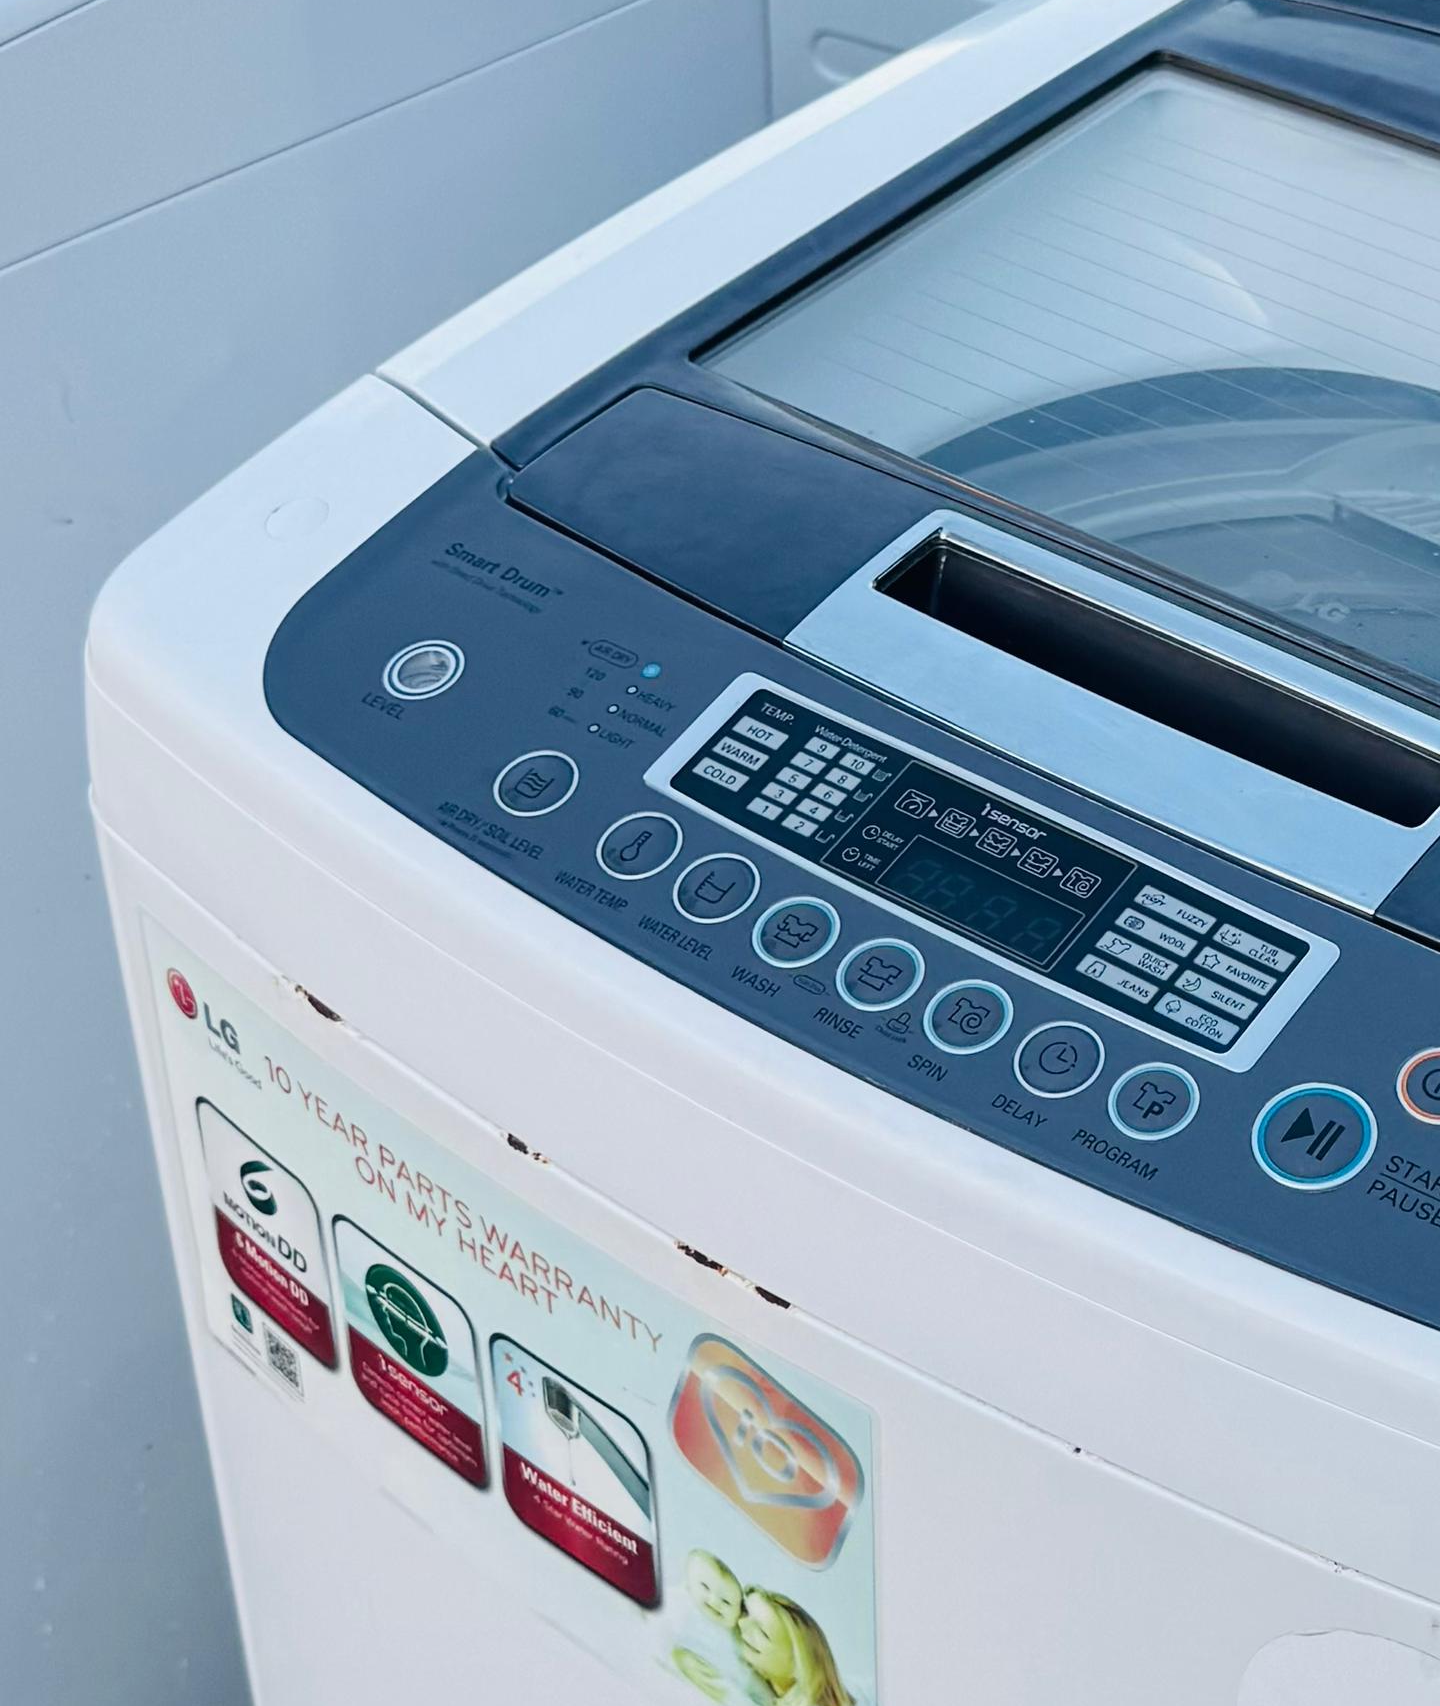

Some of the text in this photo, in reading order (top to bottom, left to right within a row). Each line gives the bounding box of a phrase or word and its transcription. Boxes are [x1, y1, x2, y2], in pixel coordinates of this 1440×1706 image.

[445, 542, 501, 574] Smart
[361, 692, 405, 720] LEVEL
[637, 690, 677, 712] HEAVY
[618, 709, 667, 738] NORMAL
[760, 703, 794, 725] TEMP.
[599, 729, 636, 750] LIGHT
[747, 724, 774, 742] HOT
[720, 743, 761, 766] WARM
[851, 759, 864, 772] 10
[703, 764, 737, 786] COLD
[554, 870, 629, 911] WATER TEMP
[1176, 908, 1209, 928] FUZZY
[637, 915, 714, 962] WATER LEVEL
[1159, 932, 1187, 951] WOOL
[1142, 953, 1171, 970] QUICK
[1248, 949, 1280, 967] CLEAN
[1260, 944, 1280, 957] TUB
[1137, 960, 1166, 976] WASH
[1225, 965, 1270, 991] FAVORITE
[731, 965, 782, 997] WASH
[1117, 980, 1150, 999] JEANS
[1211, 990, 1247, 1012] SILENT
[203, 1001, 240, 1054] LG
[813, 1007, 864, 1039] RINSE
[1185, 1017, 1223, 1039] COTTON
[1199, 1014, 1218, 1028] ECO
[907, 1054, 949, 1083] SPIN
[991, 1094, 1049, 1129] DELAY
[1071, 1128, 1159, 1181] PROGRAM
[264, 1056, 663, 1352] 10 YEAR PARTS WARRANTY
[355, 1156, 559, 1314] ON MY HEART
[506, 1370, 524, 1396] 4
[520, 1461, 639, 1555] Water Efficient
